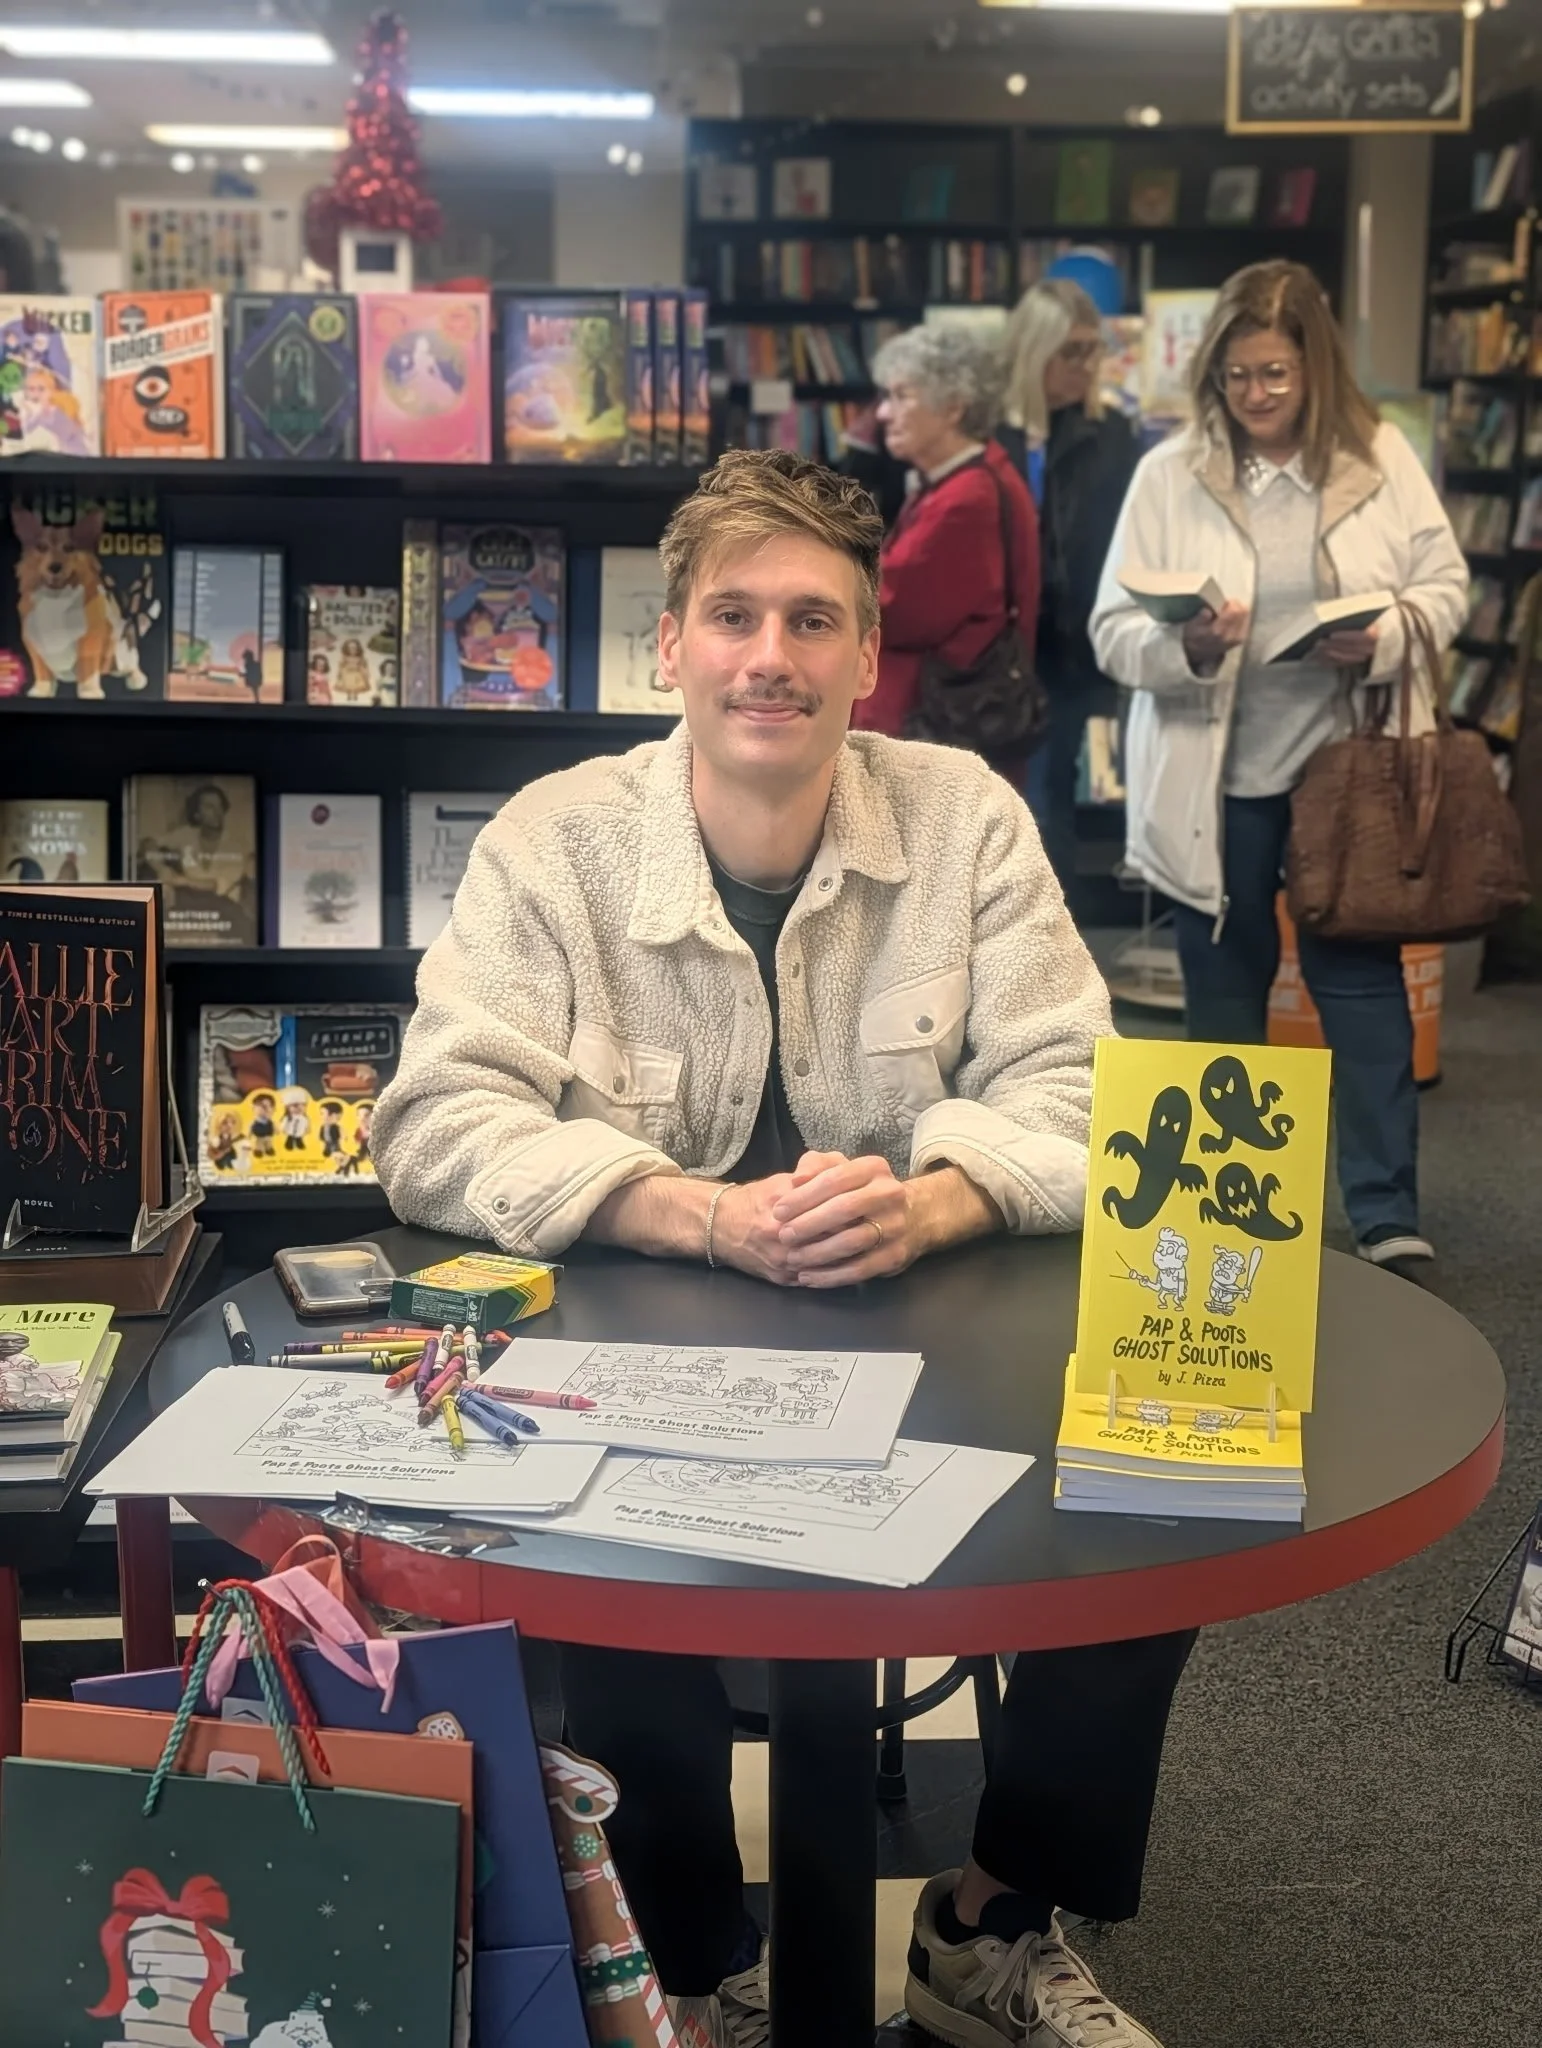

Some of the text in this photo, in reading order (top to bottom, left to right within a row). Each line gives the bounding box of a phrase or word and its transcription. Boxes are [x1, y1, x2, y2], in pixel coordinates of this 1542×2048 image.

[1251, 78, 1357, 118] activity
[99, 533, 163, 555] DOGS
[334, 615, 373, 627] DOLLS
[8, 911, 136, 926] TIMES BESTSELLING AUTHOR
[24, 1199, 54, 1208] NOVEL
[16, 1310, 96, 1324] More
[1139, 1315, 1247, 1345] PAP & POOTS
[1113, 1336, 1273, 1372] GHOST SOLUTIONS
[1158, 1370, 1226, 1387] by J. Pizza
[618, 1415, 655, 1424] Poots
[658, 1419, 698, 1429] Ghost
[701, 1424, 764, 1435] Solutions
[1097, 1430, 1261, 1456] GHOST SOLUTIONS
[1125, 1426, 1232, 1445] PAP & POOTS
[1144, 1446, 1157, 1454] by
[261, 1460, 287, 1468] Pap
[303, 1461, 342, 1469] Poots
[345, 1464, 386, 1472] Ghost
[390, 1466, 456, 1475] Solutions
[614, 1505, 640, 1514] Pap
[655, 1510, 693, 1521] Poots
[695, 1516, 738, 1527] Ghost
[739, 1522, 805, 1537] Solutions
